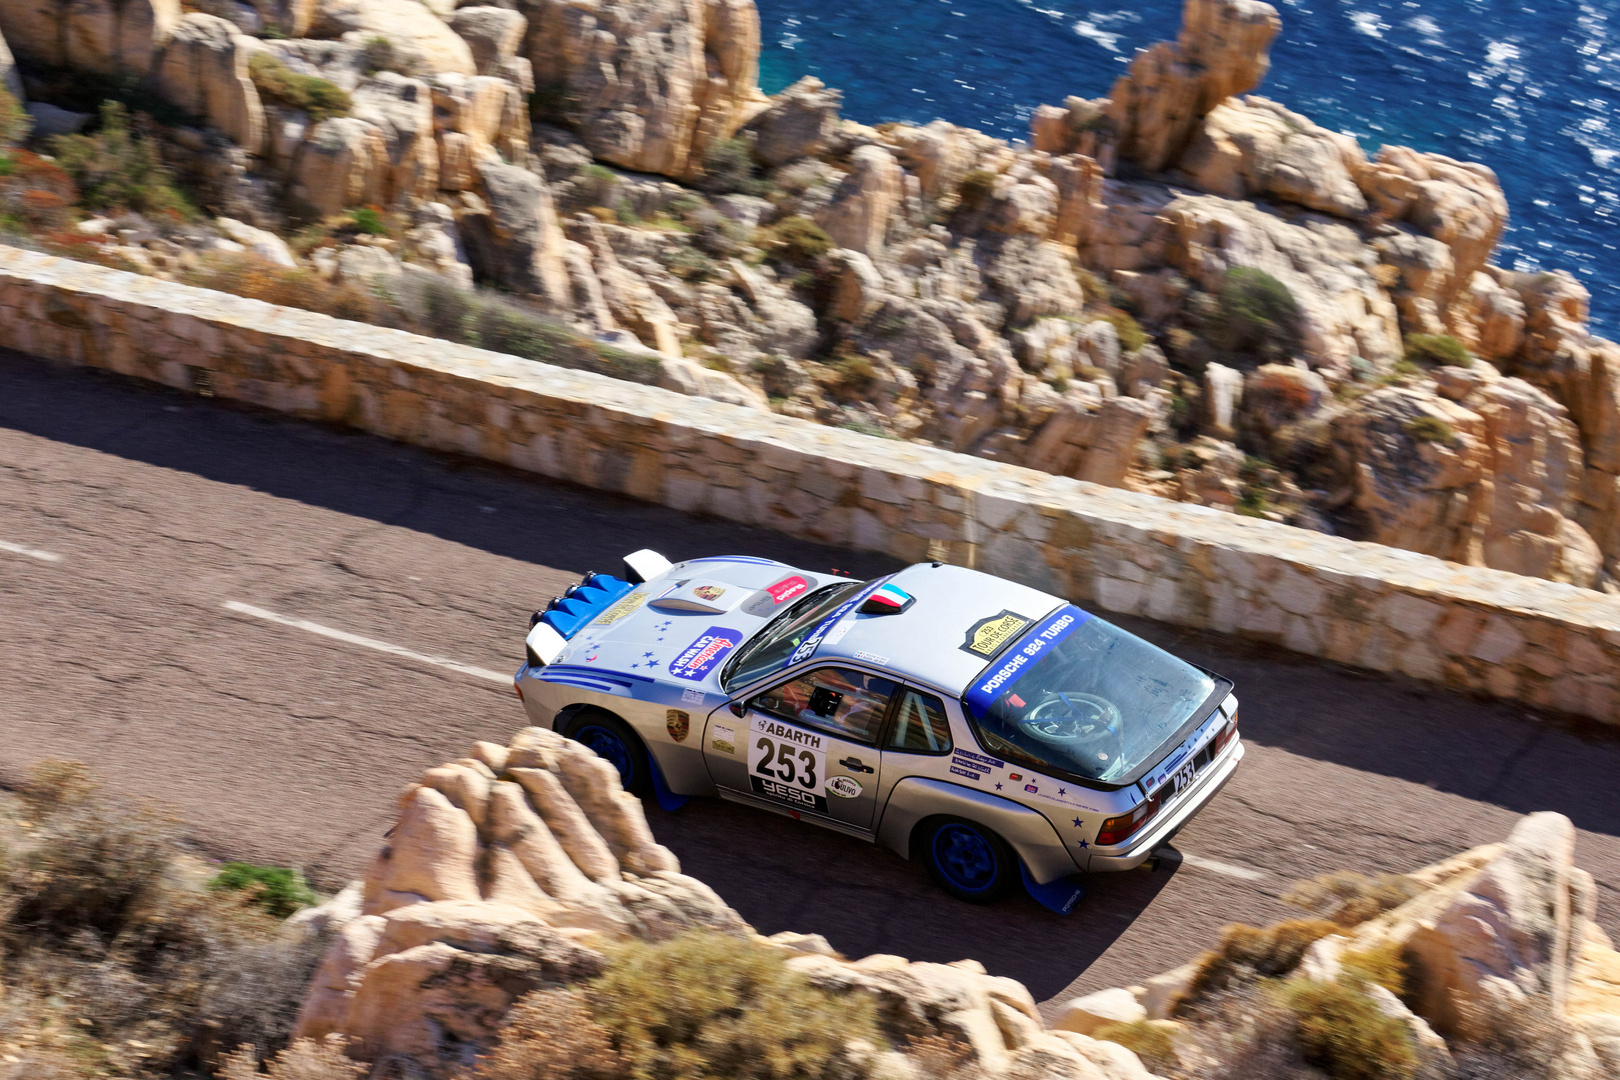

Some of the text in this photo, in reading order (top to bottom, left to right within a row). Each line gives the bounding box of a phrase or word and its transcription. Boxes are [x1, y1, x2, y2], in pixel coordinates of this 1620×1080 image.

[776, 584, 805, 600] Rapid
[692, 635, 714, 648] CAR
[972, 634, 993, 651] TOUR
[990, 628, 1002, 641] DE
[998, 615, 1019, 632] CORSE
[981, 625, 994, 635] 253
[673, 648, 702, 667] WASH
[687, 636, 734, 670] American
[792, 638, 820, 662] 253
[980, 654, 1029, 694] PORSCHE
[1023, 638, 1046, 656] 924
[1039, 614, 1075, 640] TURBO
[765, 722, 821, 749] ABARTH
[756, 737, 817, 790] 253
[1175, 762, 1194, 793] 253
[761, 779, 816, 805] YESO
